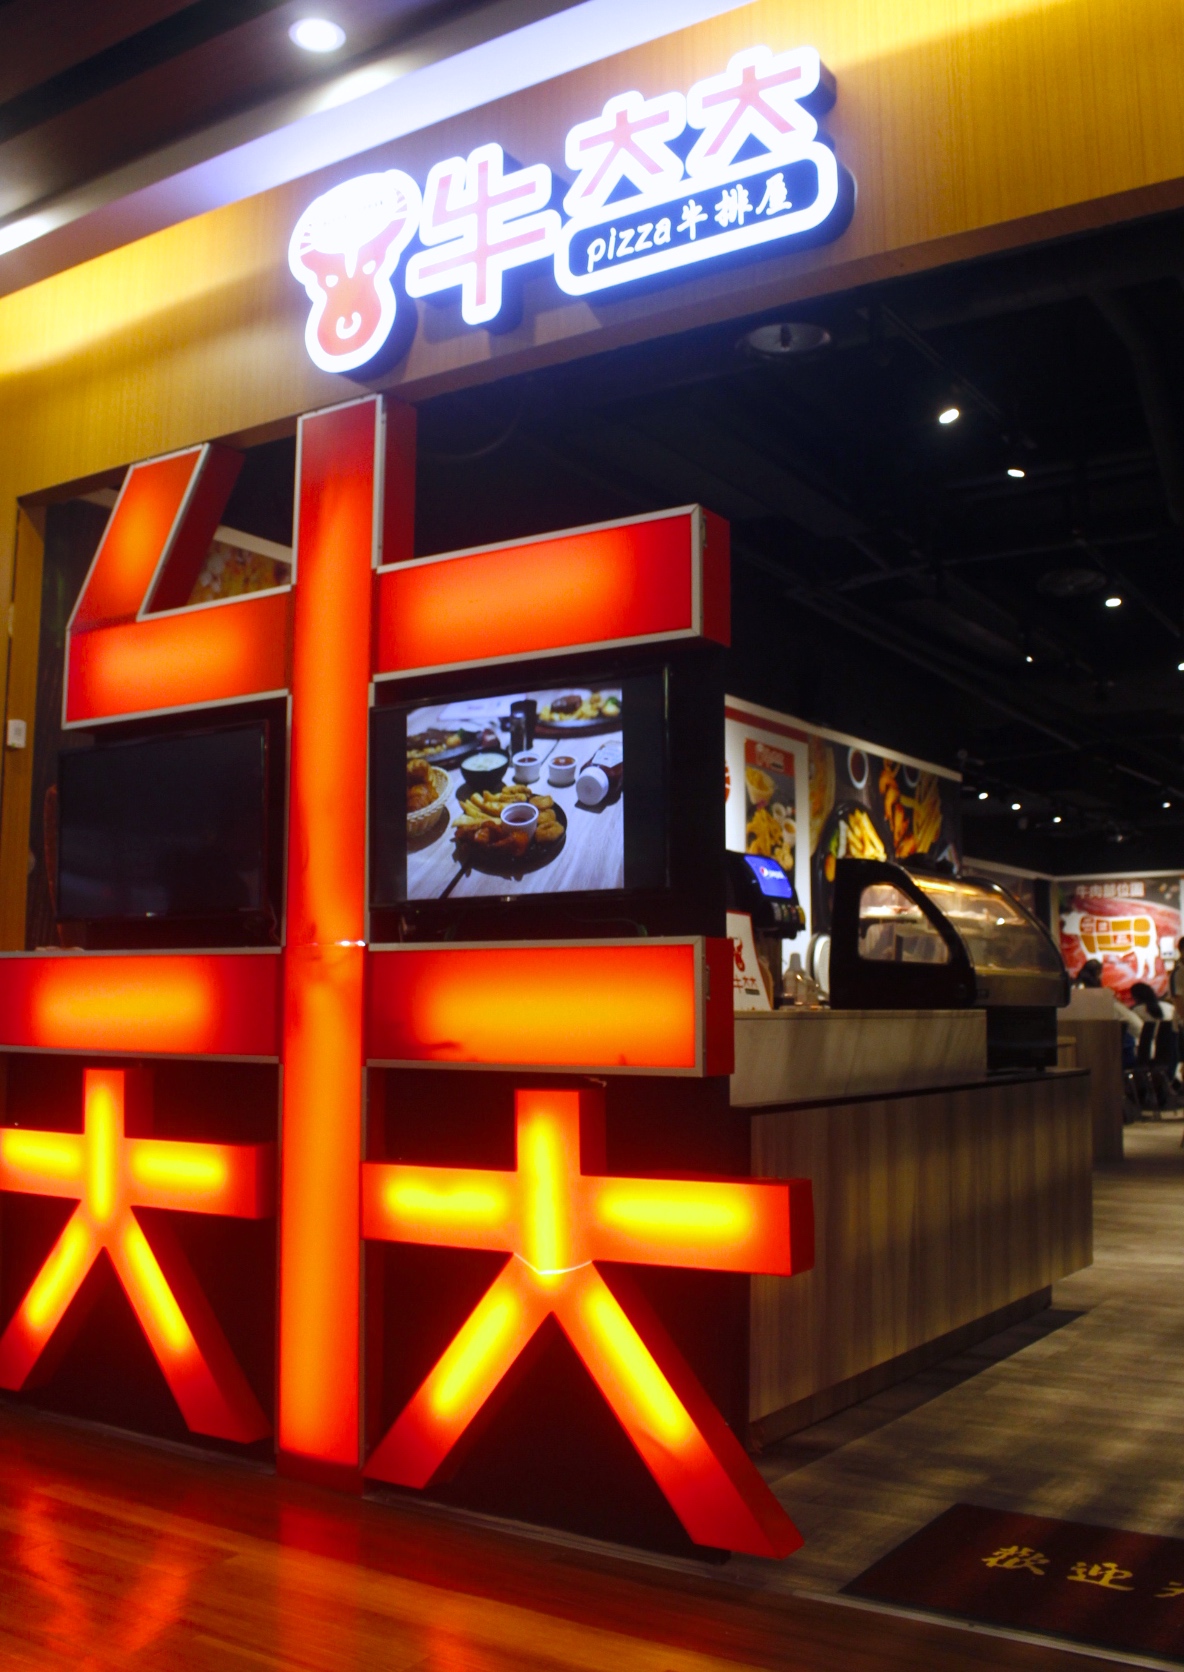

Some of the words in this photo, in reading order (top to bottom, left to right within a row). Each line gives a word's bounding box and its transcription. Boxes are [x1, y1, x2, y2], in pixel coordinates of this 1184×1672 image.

[586, 216, 672, 273] pizza
[676, 171, 793, 241] 牛排屋
